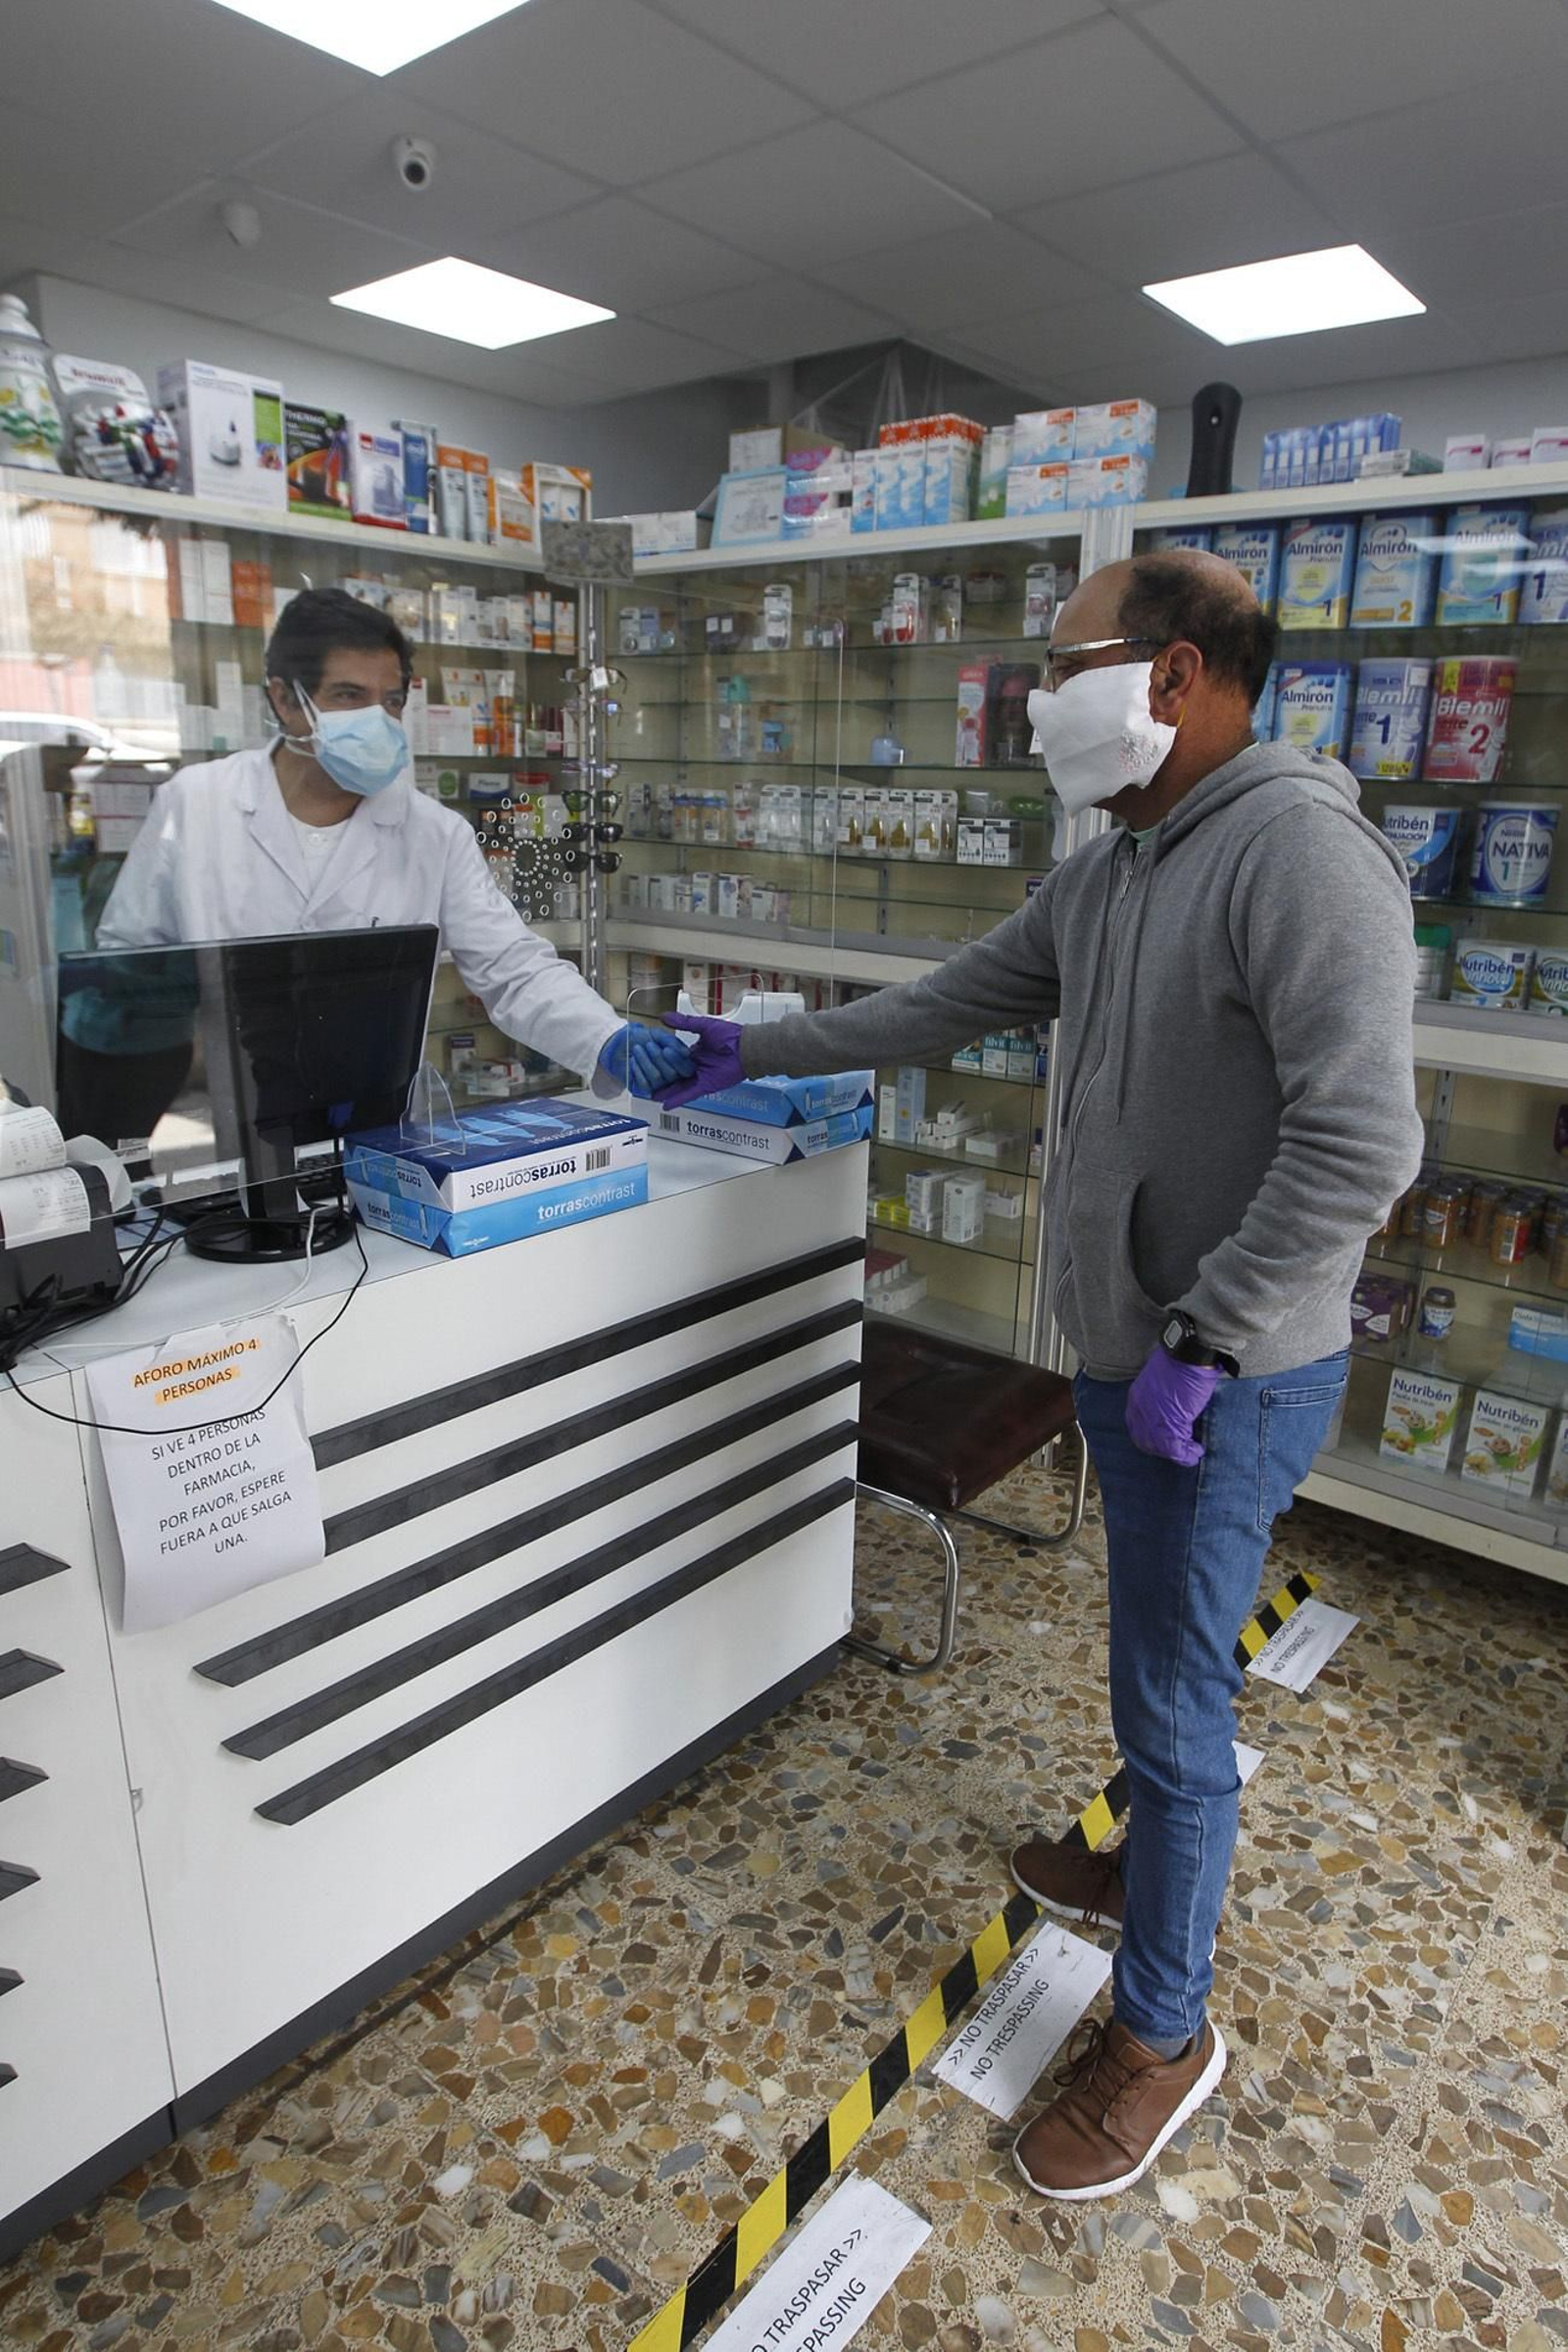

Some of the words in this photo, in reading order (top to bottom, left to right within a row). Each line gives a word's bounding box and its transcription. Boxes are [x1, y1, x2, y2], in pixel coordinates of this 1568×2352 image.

[1217, 546, 1267, 560] Almirón
[1288, 540, 1343, 556] Almirón
[1360, 539, 1419, 558] Almirón
[1534, 569, 1545, 601] 1
[1323, 599, 1332, 617] 1
[1396, 599, 1413, 621] 2
[1493, 592, 1502, 612] 1
[1282, 689, 1334, 704] Almirón
[1437, 697, 1506, 716] Blemil
[1376, 712, 1391, 745] 1
[1468, 723, 1491, 754] 2
[1493, 841, 1549, 859] NATIVA
[1501, 861, 1510, 881] 1
[1459, 956, 1516, 974] Nutribén
[686, 1120, 769, 1150] torrascontrast
[470, 1159, 577, 1200] torrascontrast
[537, 1182, 637, 1221] torrascontrast
[133, 1361, 183, 1388] AFORO
[187, 1342, 245, 1371] MÁXIMO
[247, 1339, 259, 1351] 4
[162, 1368, 232, 1401] PERSONAS
[1393, 1378, 1452, 1403] Nutribén
[1477, 1399, 1539, 1429] Nutribén
[151, 1446, 165, 1461] SI
[168, 1439, 185, 1454] VE
[187, 1434, 197, 1446] 4
[198, 1407, 267, 1443] PERSONAS
[168, 1446, 222, 1480] DENTRO
[225, 1439, 243, 1457] DE
[244, 1432, 262, 1449] LA
[183, 1460, 257, 1497] FARMACIA,
[159, 1512, 189, 1533] POR
[191, 1493, 238, 1519] FAVOR,
[241, 1469, 286, 1498] ESPERE
[160, 1527, 206, 1555] FUERA
[208, 1522, 220, 1537] A
[220, 1508, 249, 1531] QUE
[250, 1491, 293, 1517] SALGA
[214, 1533, 249, 1554] UNA.
[1259, 1645, 1275, 1659] NO
[1268, 1616, 1299, 1646] TRASPASAR
[1270, 1661, 1285, 1674] NO
[1279, 1626, 1315, 1663] TRESPASSING
[959, 2024, 983, 2049] NO
[976, 1960, 1031, 2026] TRASPASAR
[969, 2056, 994, 2082] NO
[985, 1978, 1051, 2057] TRESPASSING
[762, 2247, 849, 2343] TRASPASAR
